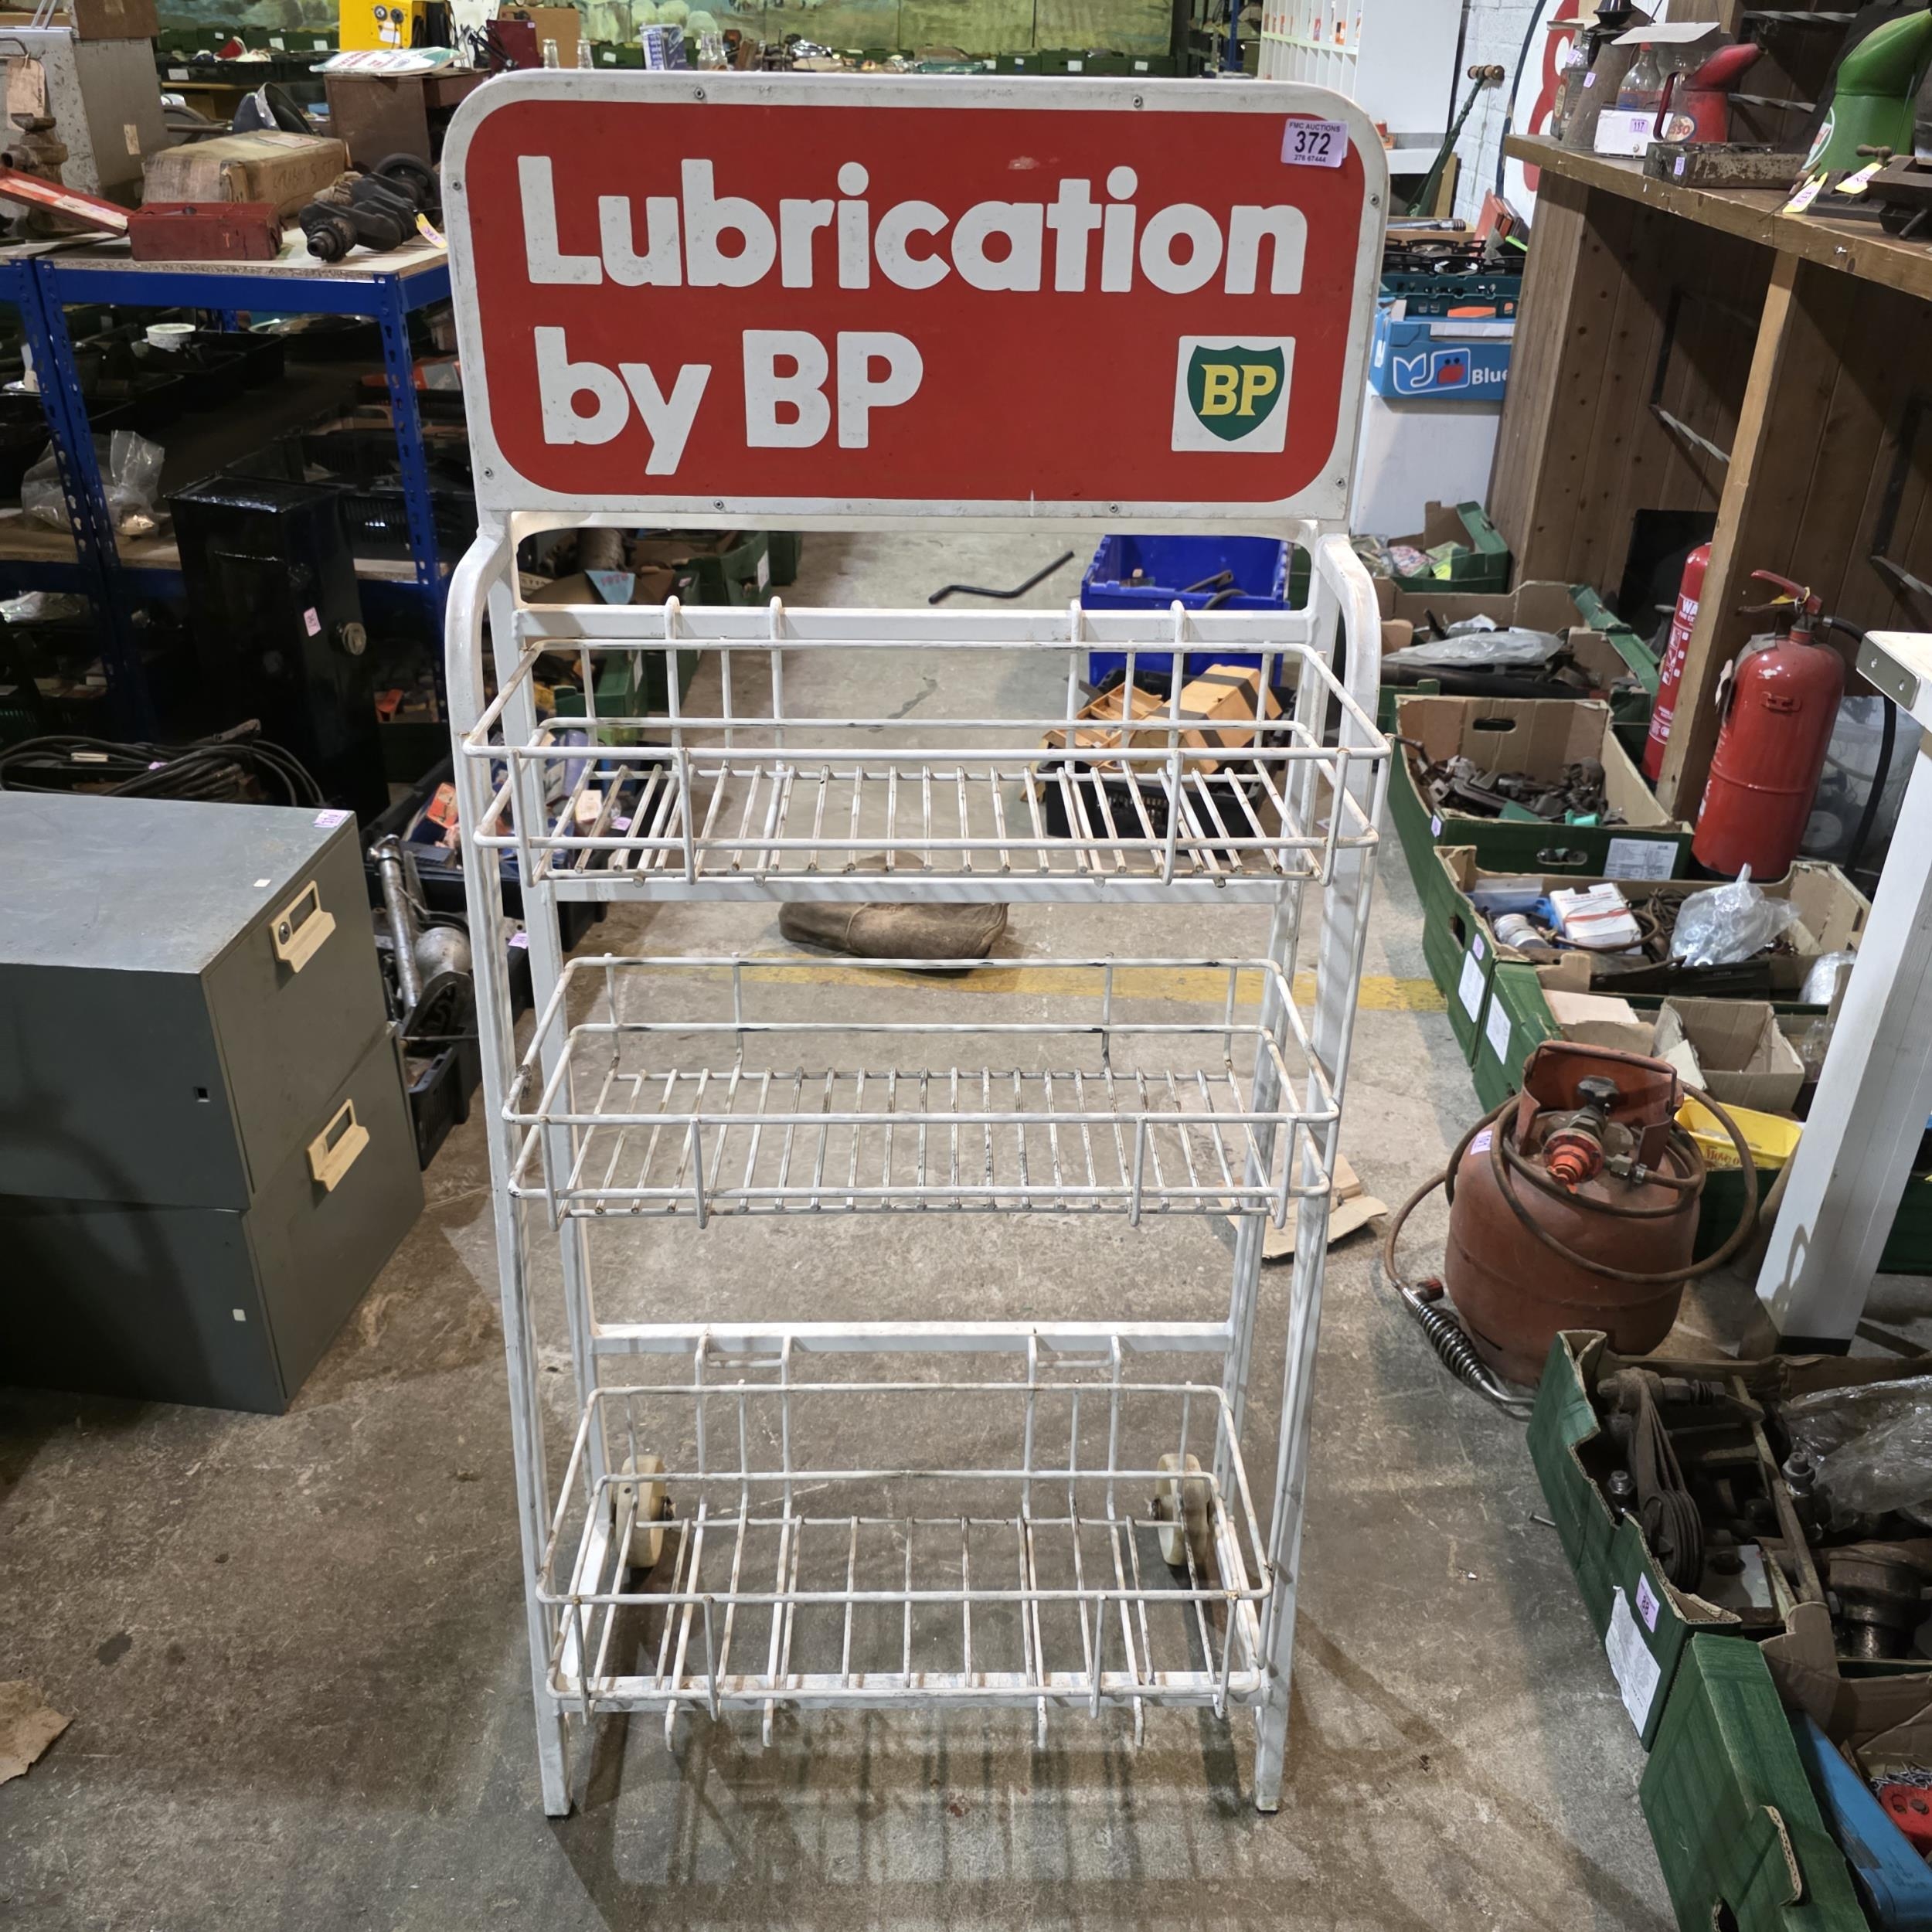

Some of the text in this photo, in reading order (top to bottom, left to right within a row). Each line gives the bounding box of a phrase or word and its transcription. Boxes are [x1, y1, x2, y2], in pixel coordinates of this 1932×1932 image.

[1294, 131, 1331, 155] 372
[1305, 124, 1340, 132] AUCTIONS
[1634, 121, 1645, 130] 117
[517, 155, 1308, 294] Lubrication
[533, 326, 923, 475] by BP
[1199, 364, 1277, 416] BP
